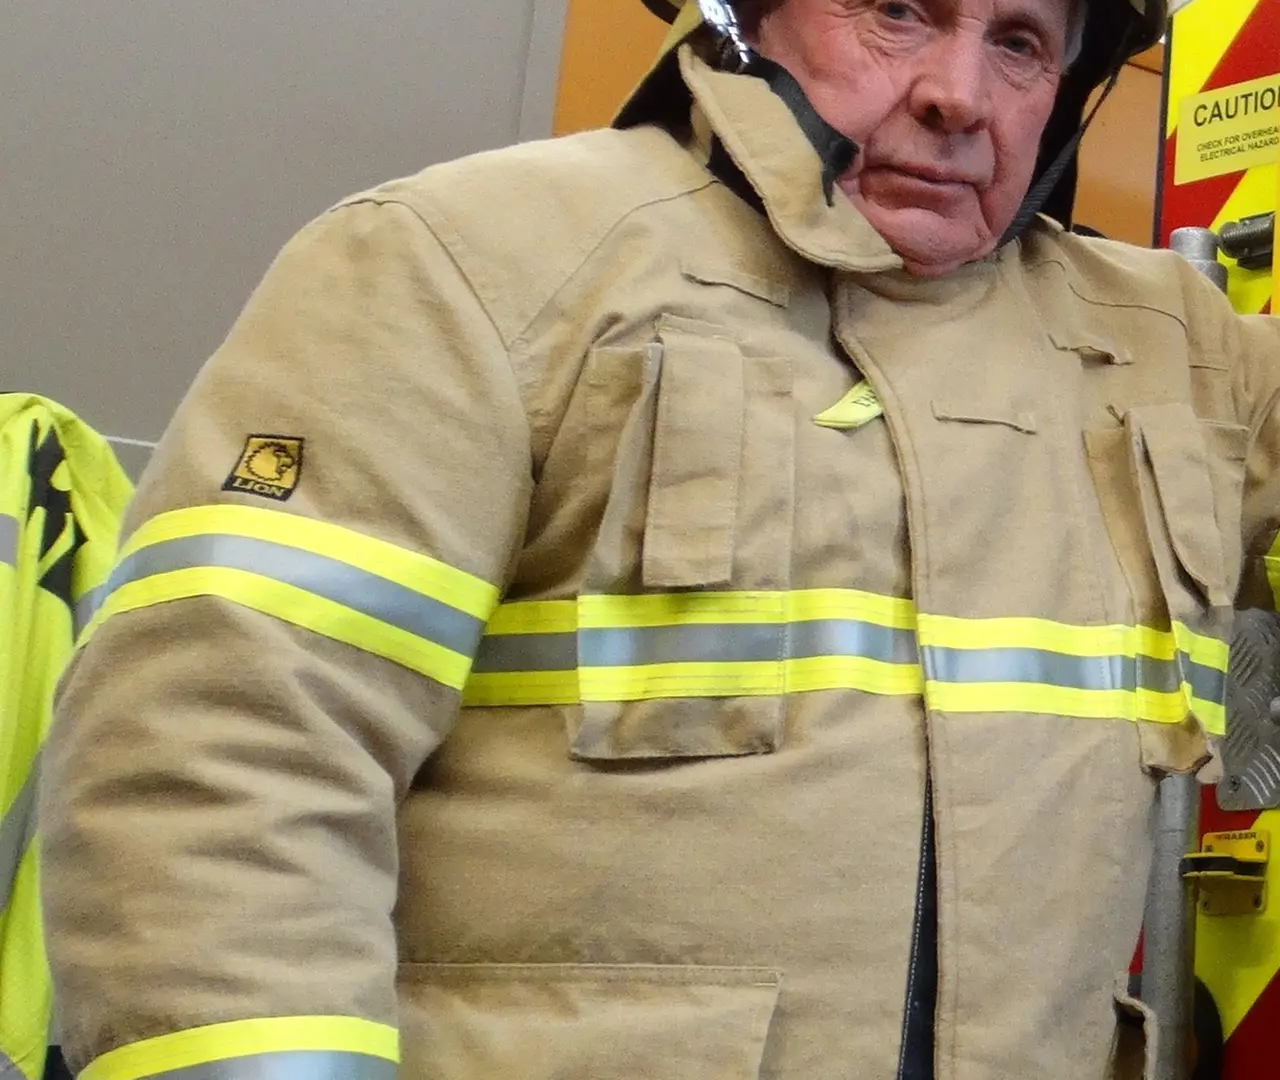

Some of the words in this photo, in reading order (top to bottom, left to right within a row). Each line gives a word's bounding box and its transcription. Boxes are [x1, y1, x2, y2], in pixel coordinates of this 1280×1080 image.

[1197, 139, 1222, 152] CHECK
[1224, 134, 1240, 146] FOR
[1242, 125, 1280, 142] OVERHEA
[1200, 145, 1245, 162] ELECTRICAL
[233, 478, 285, 497] LION
